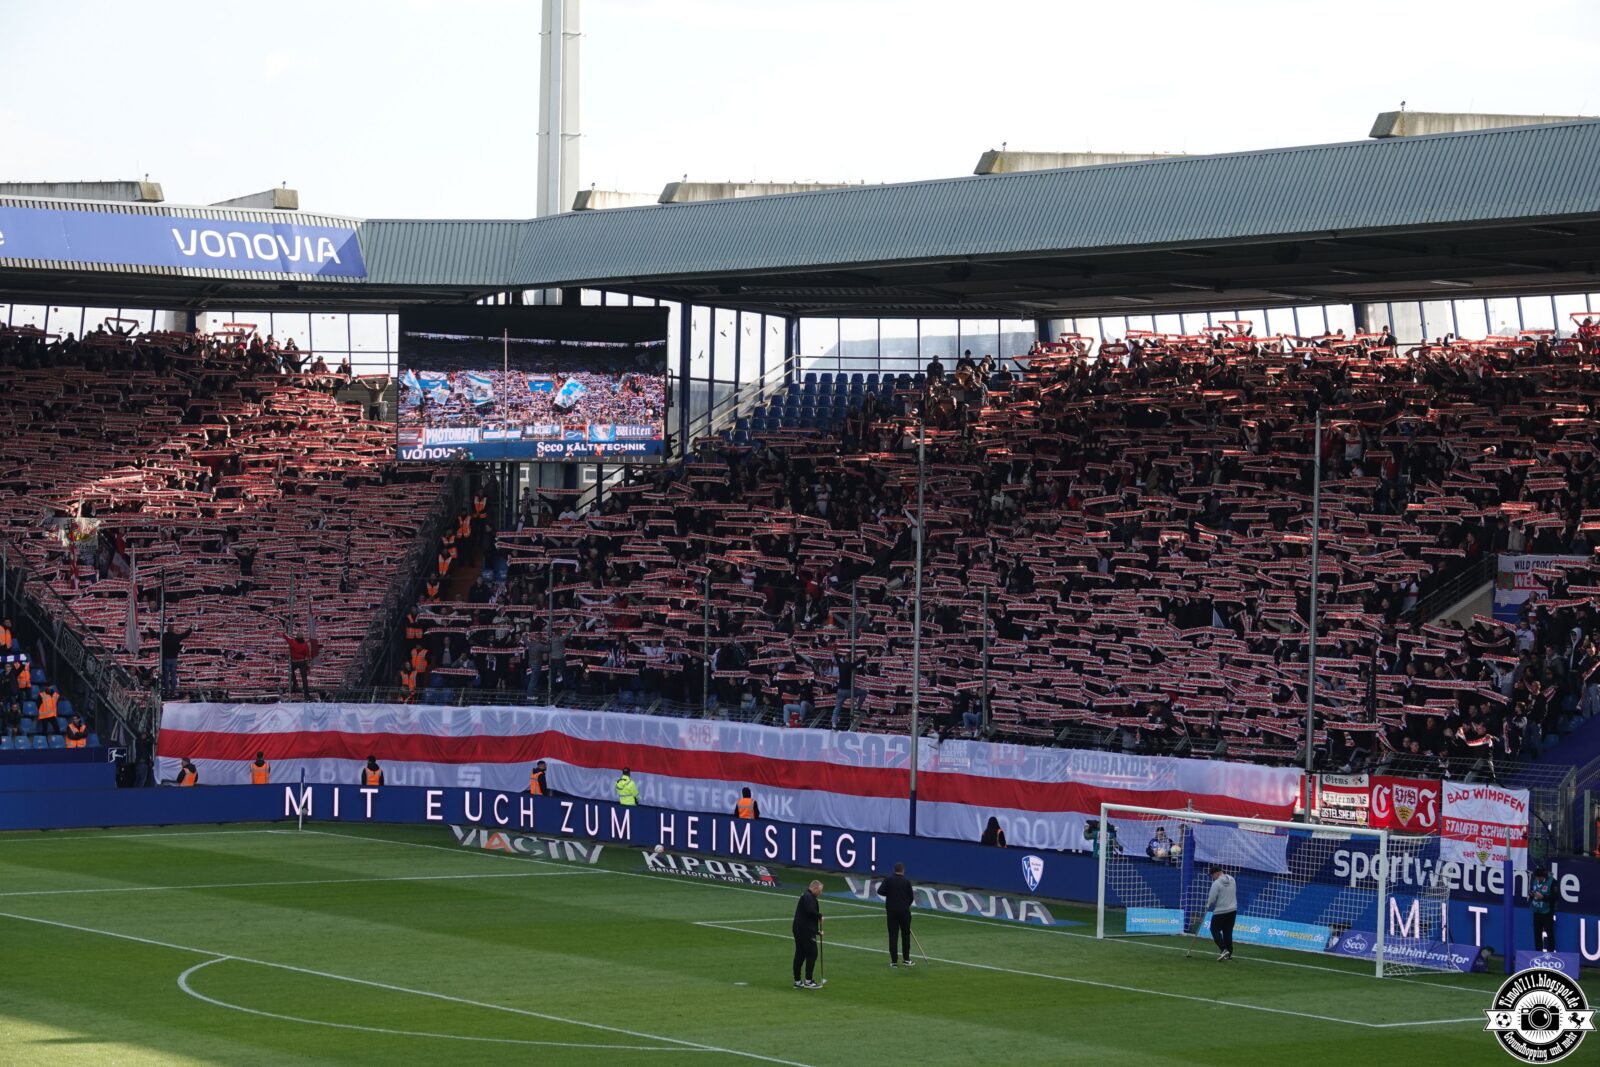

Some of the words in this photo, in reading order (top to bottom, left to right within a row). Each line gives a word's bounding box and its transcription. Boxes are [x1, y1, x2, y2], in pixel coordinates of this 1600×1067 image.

[425, 428, 479, 442] PHOTOMAFIA
[537, 441, 564, 453] Seco
[566, 441, 646, 452] KÄLTTECHNIK
[1447, 789, 1470, 804] BAD
[1473, 787, 1525, 813] WIMPFEN
[284, 786, 379, 818] MIT
[426, 790, 534, 829] EUCH
[560, 801, 631, 841] ZUM
[660, 812, 877, 871] HEIMSIEG!
[1445, 819, 1479, 835] STAUFER
[642, 851, 753, 880] KIPOR
[648, 865, 716, 879] Generatoren
[722, 875, 744, 884] vom
[1389, 896, 1489, 948] MIT
[1344, 937, 1367, 952] Seco
[1450, 953, 1470, 964] Tor
[1533, 958, 1562, 970] Seco
